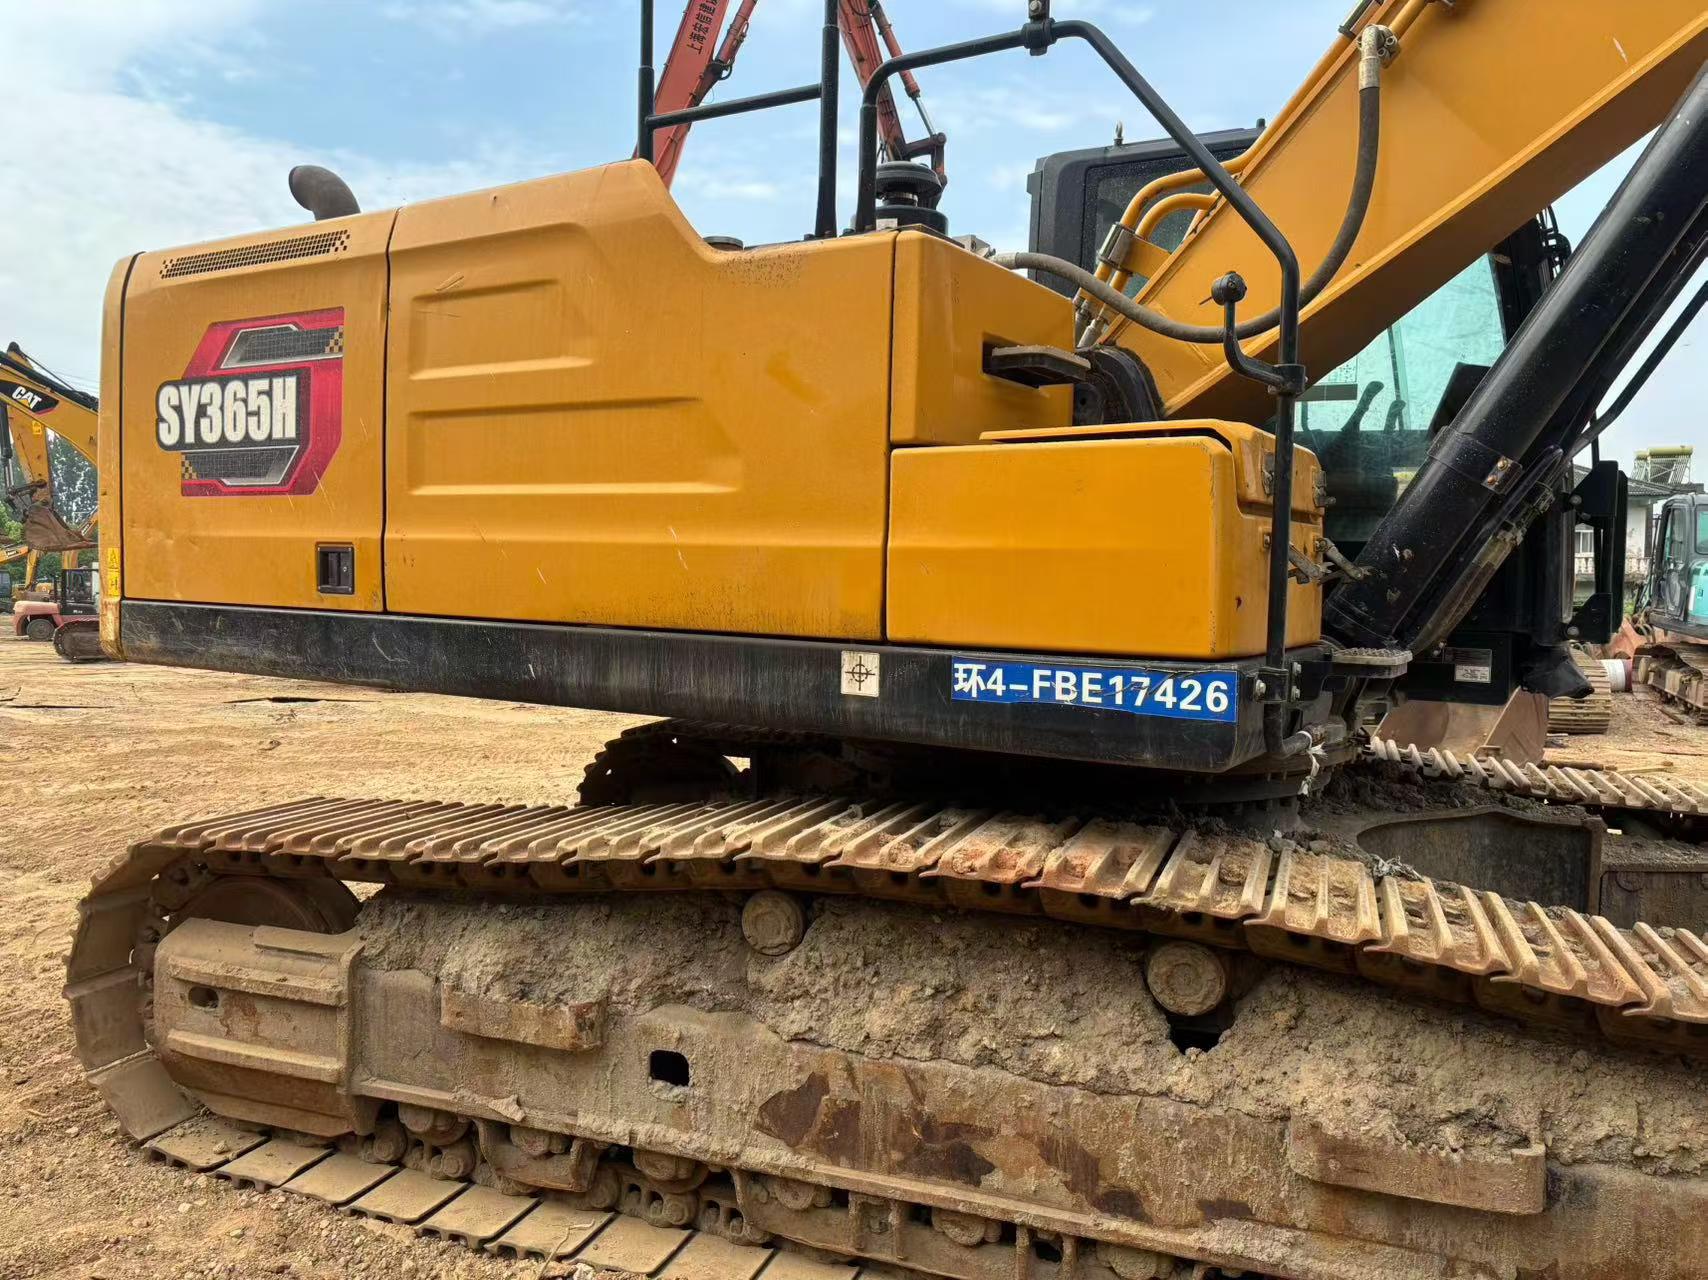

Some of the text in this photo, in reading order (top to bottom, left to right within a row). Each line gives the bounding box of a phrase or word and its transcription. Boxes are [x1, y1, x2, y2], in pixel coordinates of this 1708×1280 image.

[12, 386, 42, 409] CAT
[158, 375, 297, 446] SY365H
[953, 663, 1229, 713] 环4-FBE17426
